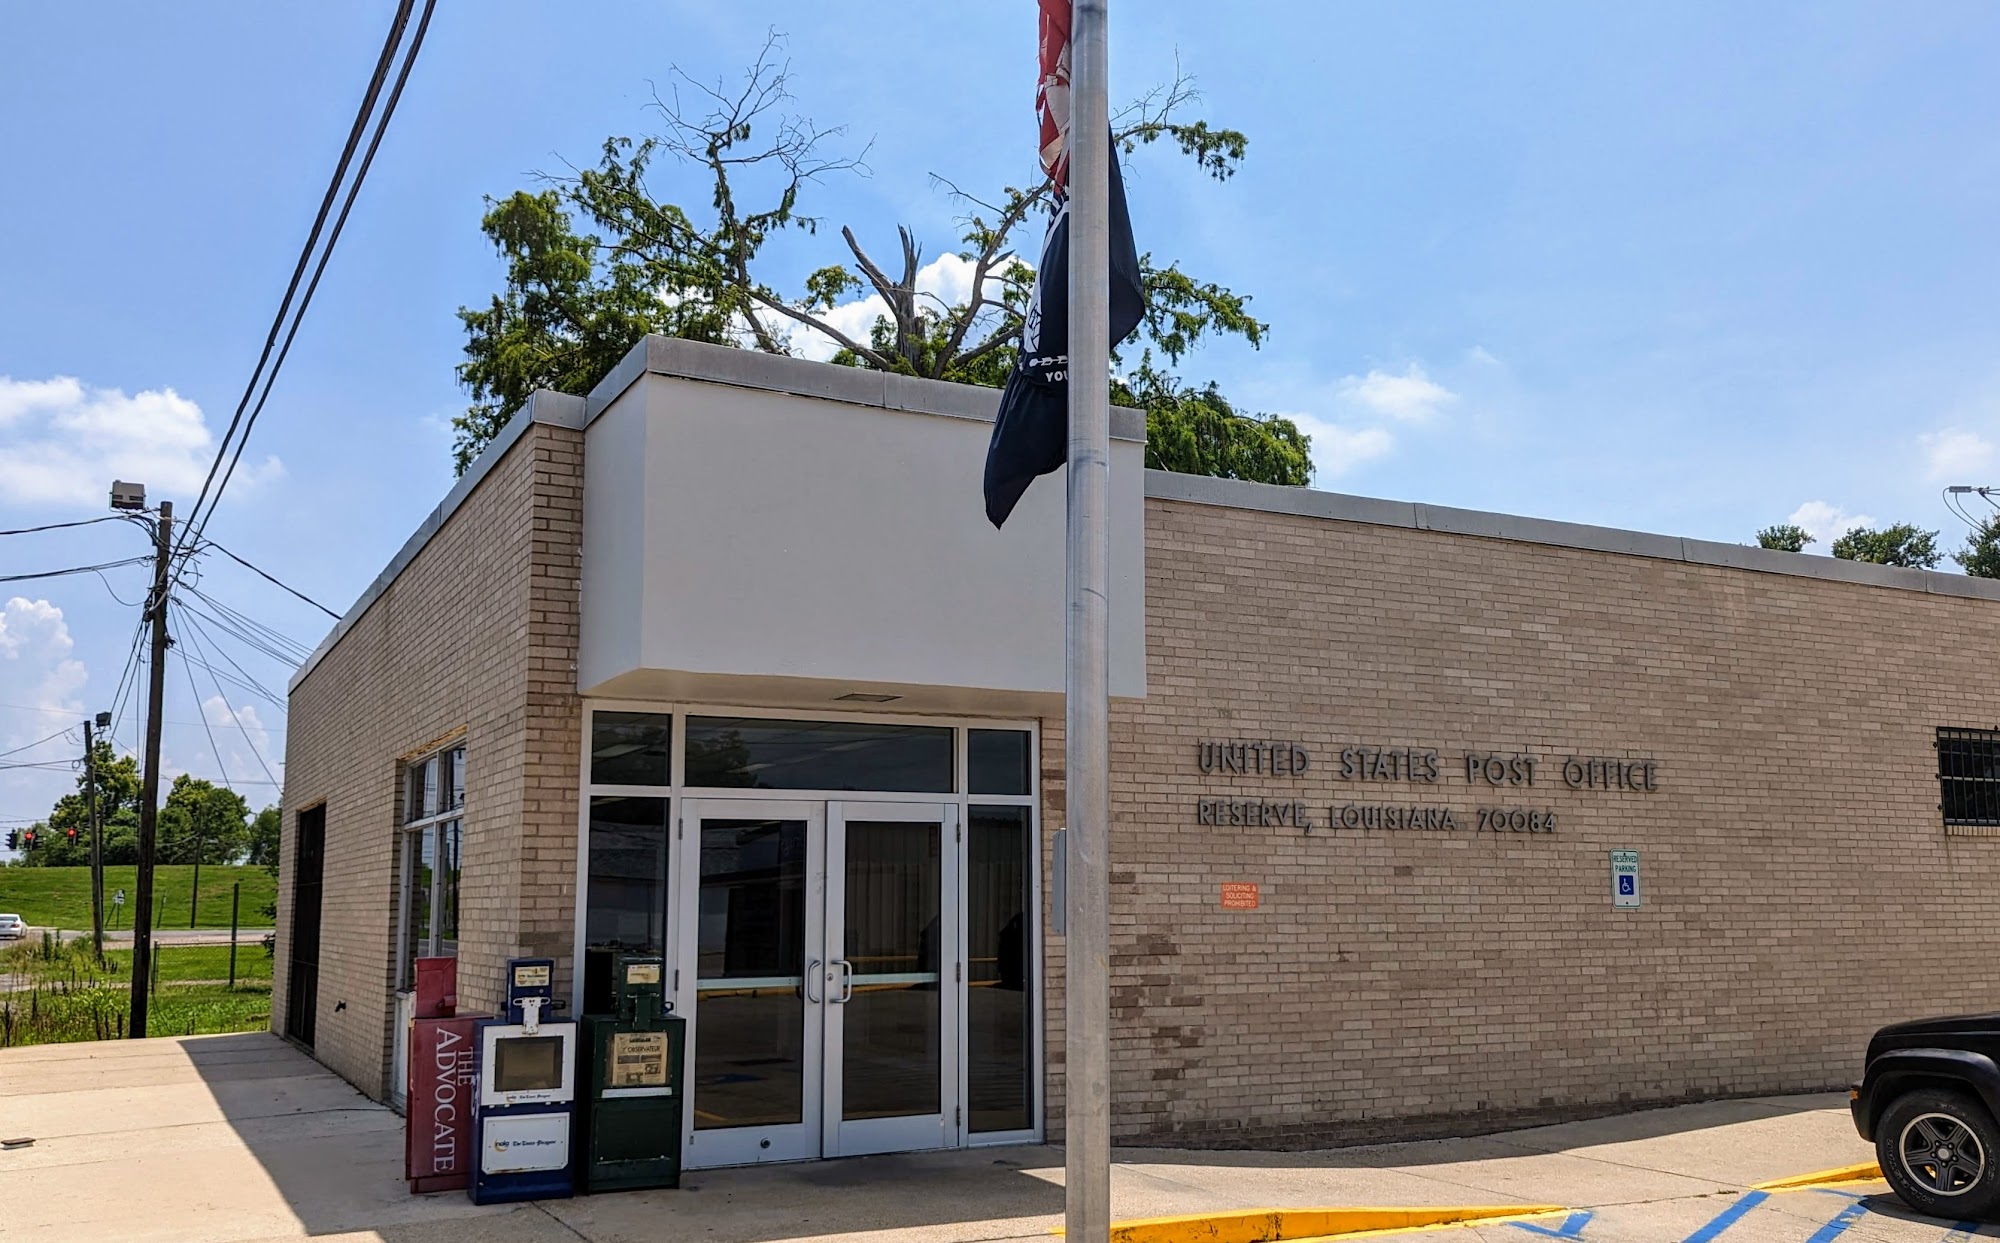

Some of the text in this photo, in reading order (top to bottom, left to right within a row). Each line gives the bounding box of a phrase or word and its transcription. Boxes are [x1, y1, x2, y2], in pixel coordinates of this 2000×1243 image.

[1199, 742, 1658, 791] UNITED STATES POST OFFICE
[1199, 801, 1557, 834] RESERVE, LOUISIANA 70084
[1613, 855, 1637, 863] RESERVED
[1222, 884, 1250, 892] LOITERING
[1224, 899, 1256, 907] PROHIBITED
[457, 1046, 474, 1087] THE
[433, 1027, 463, 1172] ADVOCATE
